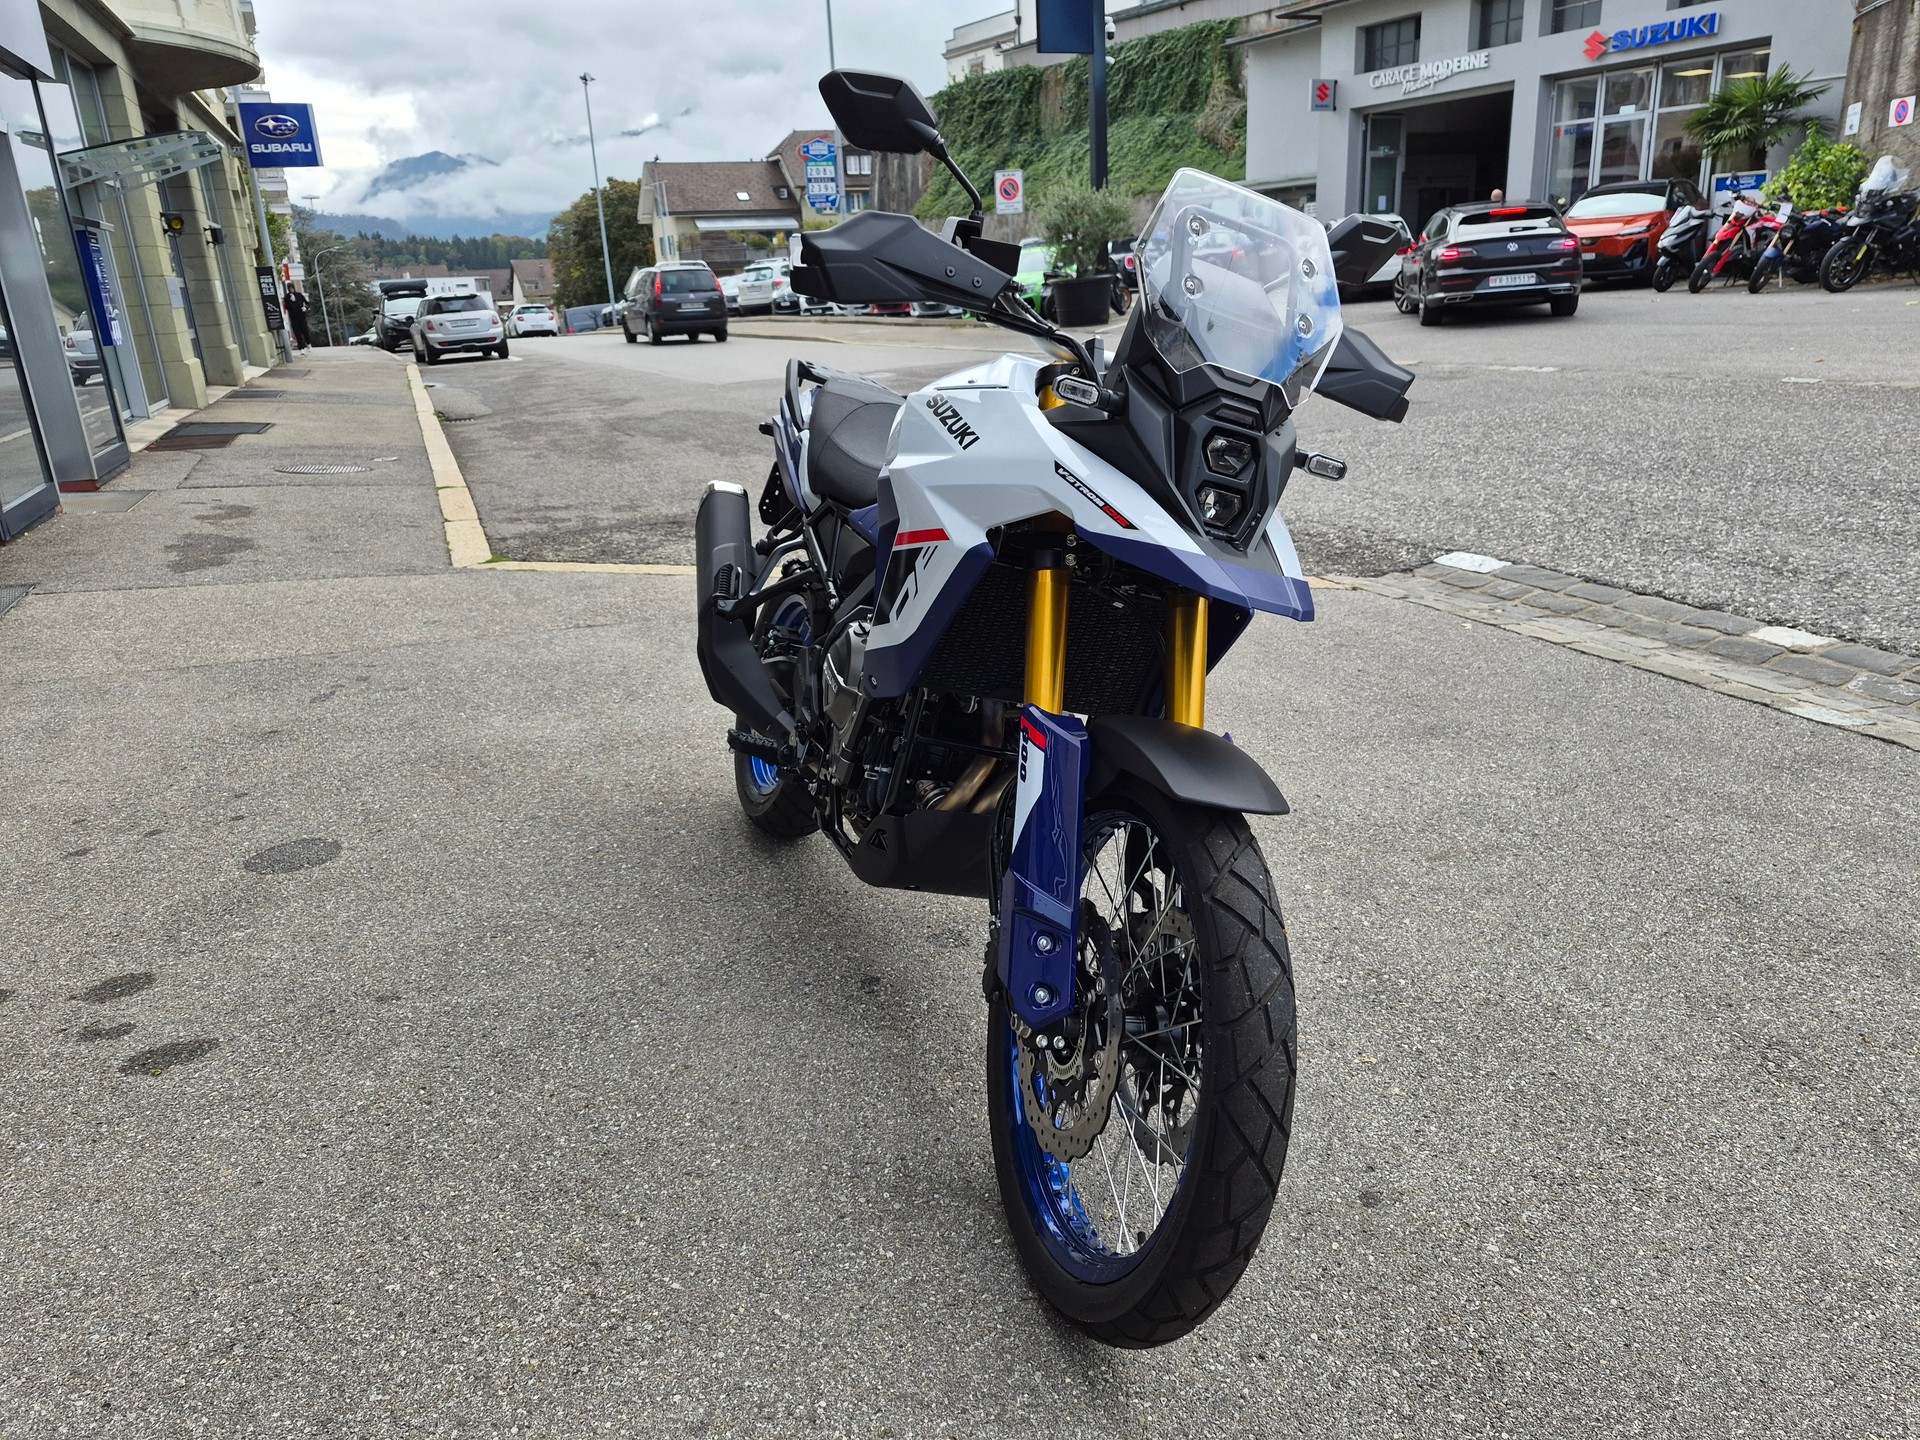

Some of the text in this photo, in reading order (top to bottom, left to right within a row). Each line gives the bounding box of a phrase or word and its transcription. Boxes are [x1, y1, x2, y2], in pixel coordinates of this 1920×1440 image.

[1612, 12, 1720, 51] SUZUKI
[1369, 52, 1489, 88] GARAGE MODERNE
[250, 143, 312, 153] SUBARU
[926, 394, 981, 451] SUZUKI
[1057, 467, 1106, 508] V-STROM
